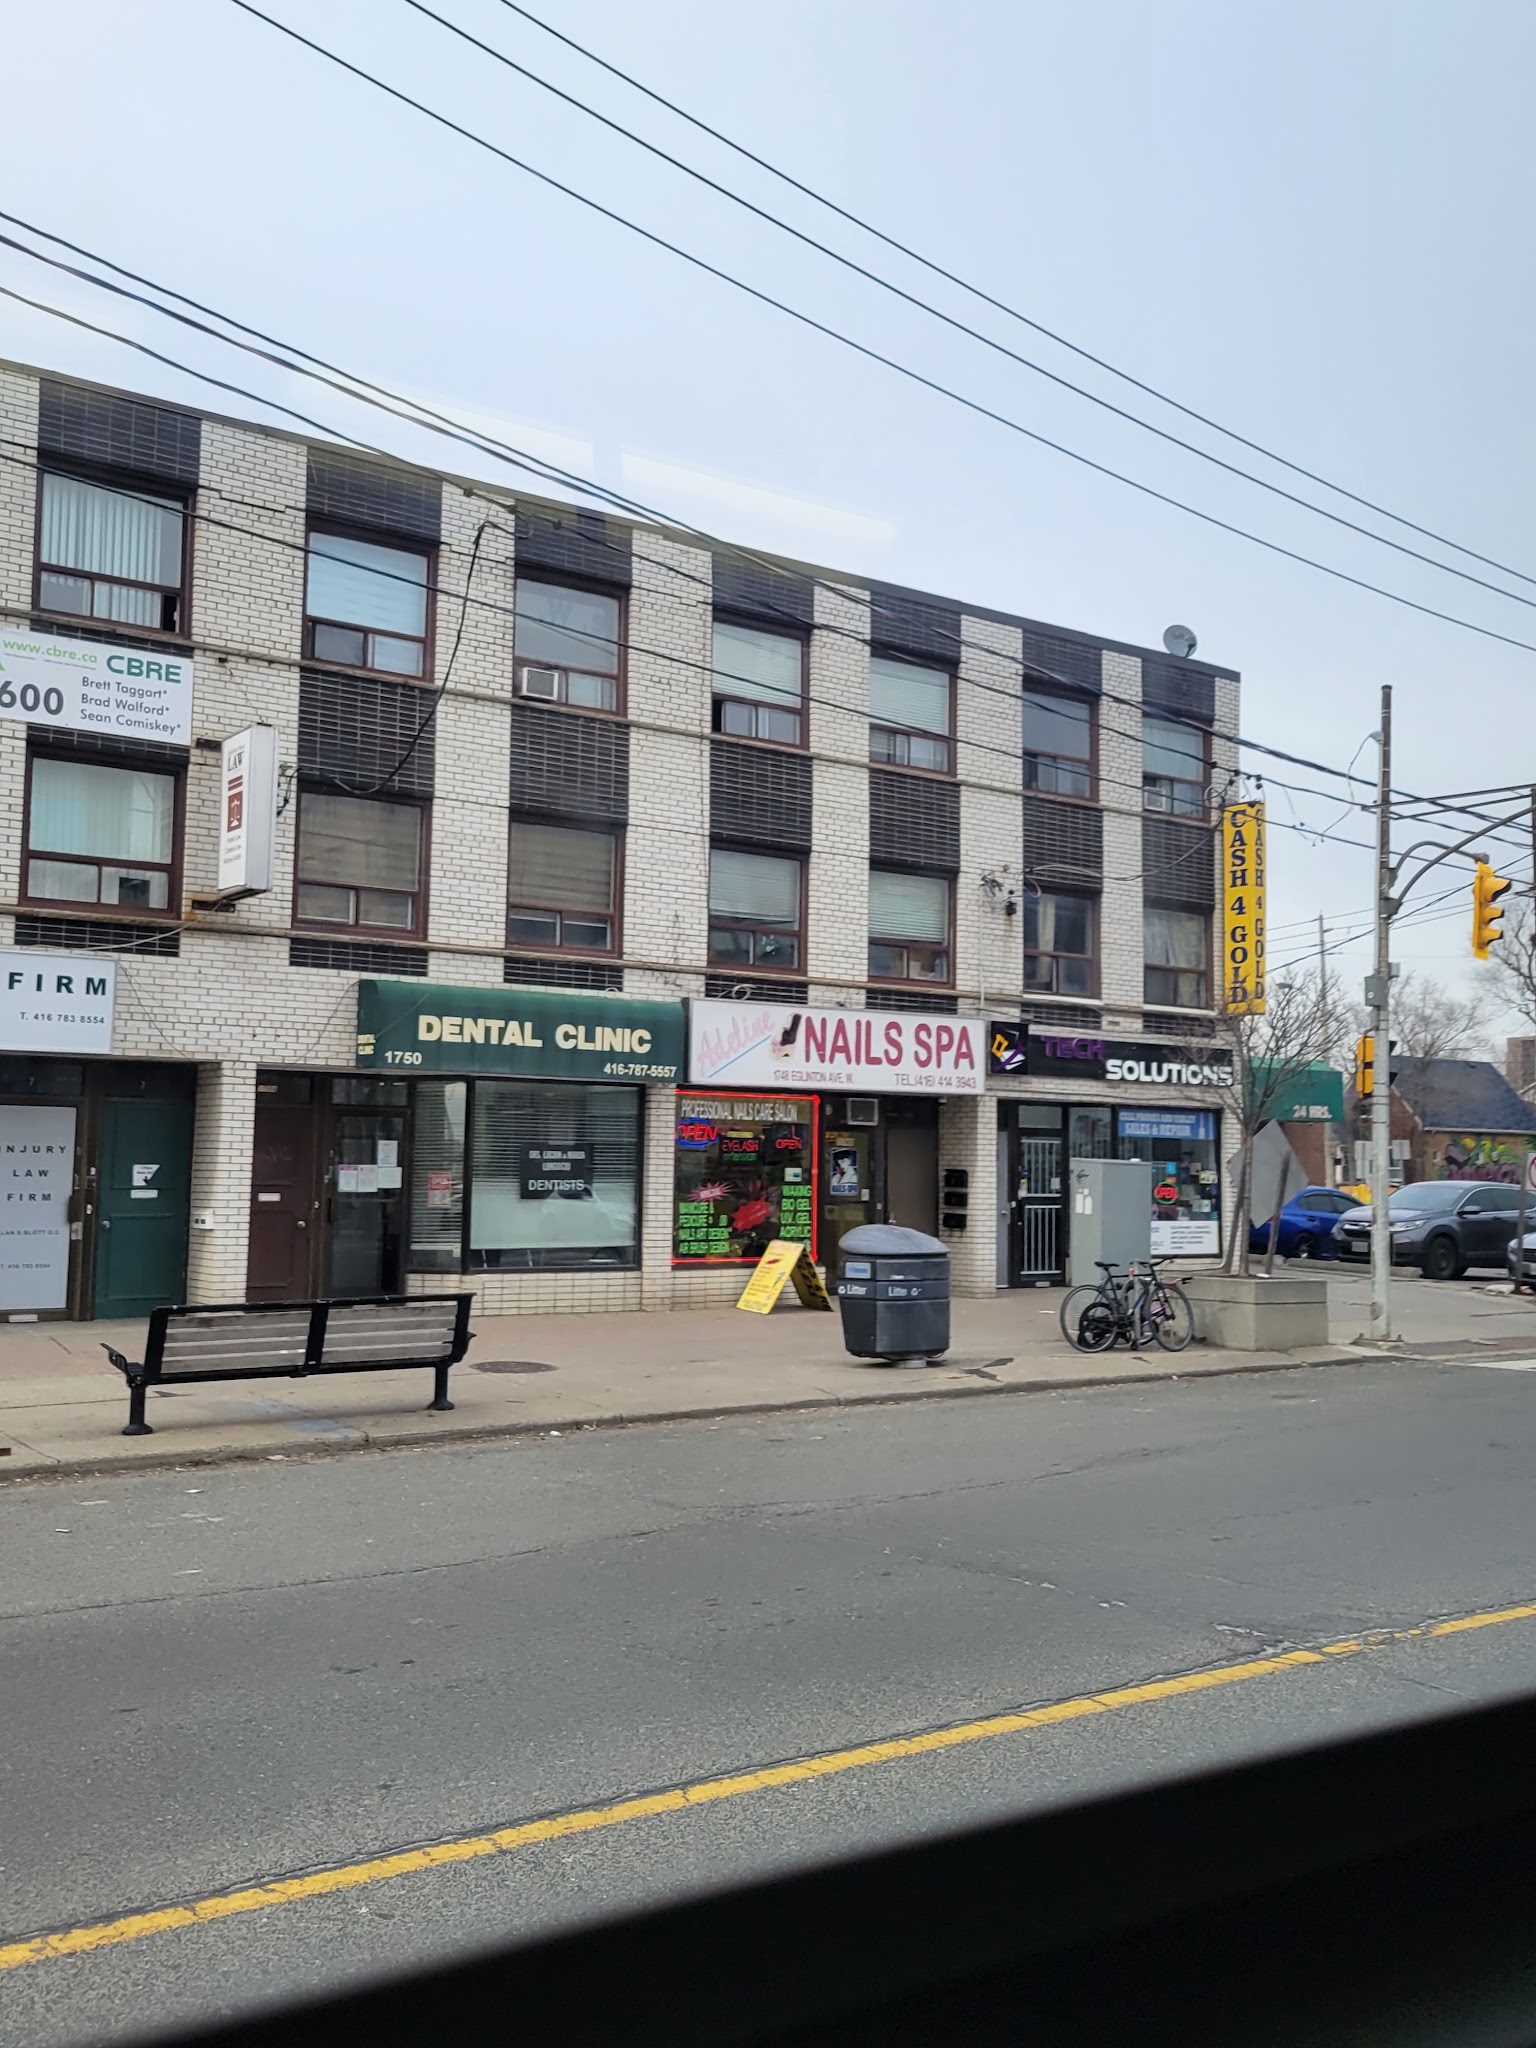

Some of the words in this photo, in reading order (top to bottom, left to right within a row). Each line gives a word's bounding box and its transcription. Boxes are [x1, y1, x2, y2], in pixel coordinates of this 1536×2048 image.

[3, 640, 97, 663] www.cbre.ca
[106, 655, 182, 684] CBRE
[82, 676, 110, 690] Brett
[0, 680, 64, 716] 600
[81, 693, 110, 707] Brad
[80, 709, 111, 723] Sean
[227, 750, 245, 772] LAW
[1229, 809, 1248, 888] CASH
[1255, 809, 1264, 887] CASH
[1230, 896, 1246, 916] 4
[1255, 896, 1263, 910] 4
[1229, 925, 1249, 1003] GOLD
[1255, 918, 1264, 999] GOLD
[8, 972, 107, 996] FIRM
[33, 1013, 52, 1022] 416
[57, 1014, 76, 1023] 783
[80, 1015, 105, 1024] 8554
[418, 1014, 543, 1048] DENTAL
[555, 1024, 652, 1054] CLINIC
[805, 1015, 903, 1066] NAILS
[914, 1023, 975, 1070] SPA
[1041, 1036, 1105, 1060] TECH
[384, 1050, 422, 1065] 1750
[603, 1062, 677, 1078] 416-787-5557
[1105, 1058, 1233, 1087] SOLUTIONS
[675, 1124, 718, 1140] OPEN
[722, 1140, 758, 1151] EYELASH
[775, 1139, 802, 1150] OPEN
[13, 1169, 49, 1177] LAW
[528, 1179, 585, 1190] DENTISTS
[7, 1193, 51, 1201] FIRM
[847, 1284, 867, 1295] Litter
[888, 1286, 907, 1296] Litter
